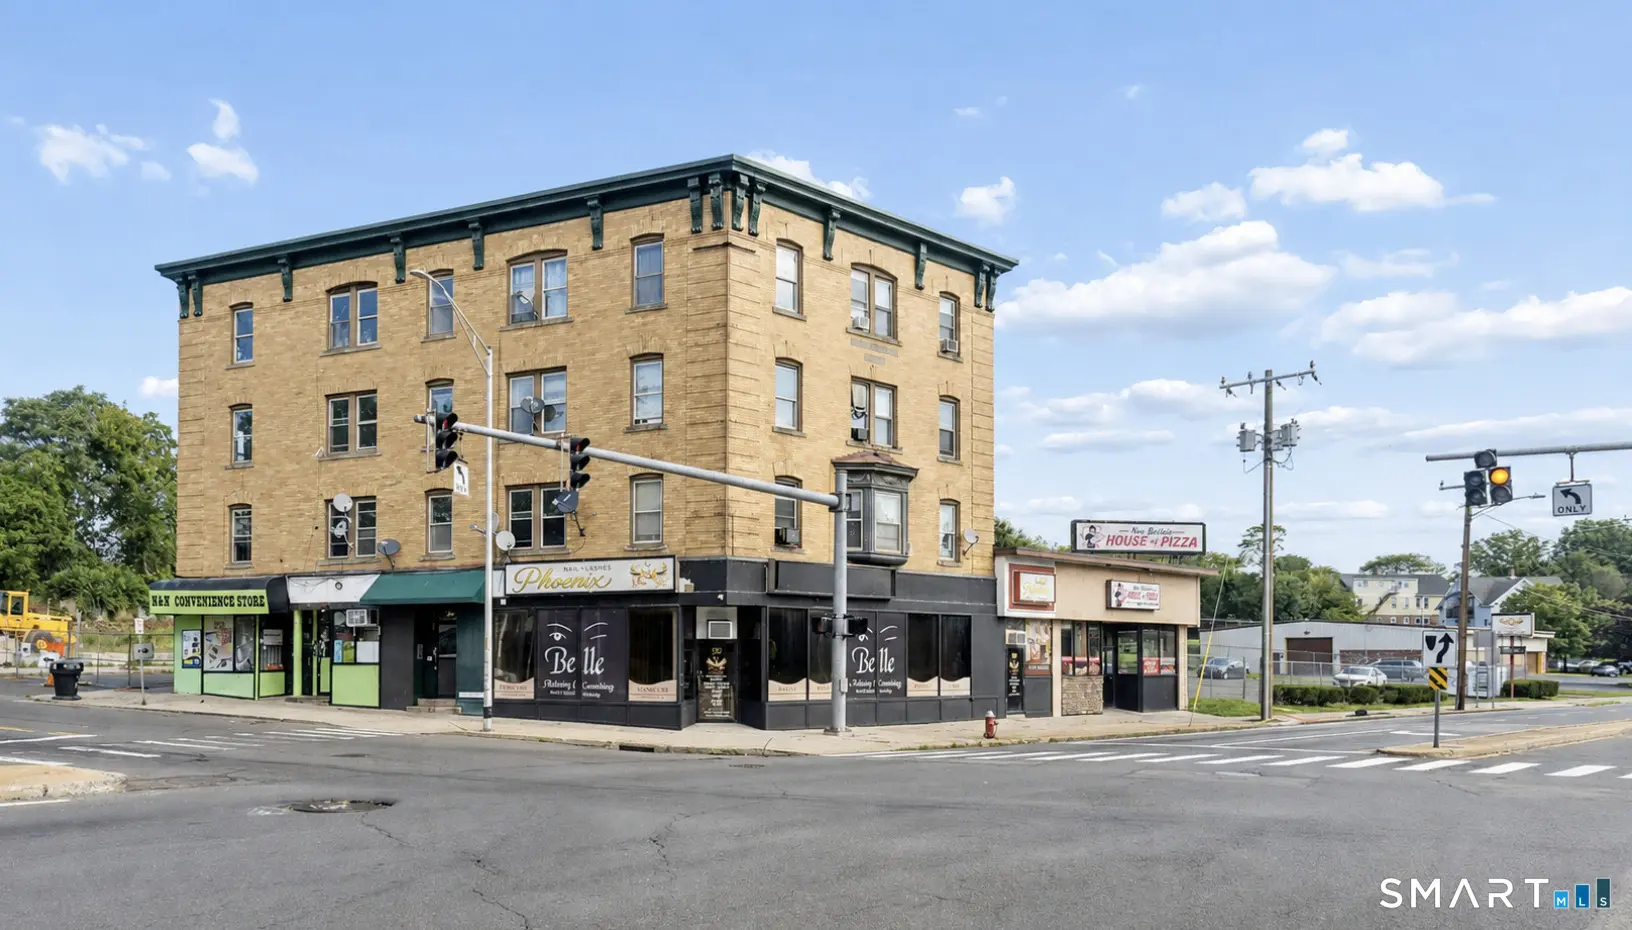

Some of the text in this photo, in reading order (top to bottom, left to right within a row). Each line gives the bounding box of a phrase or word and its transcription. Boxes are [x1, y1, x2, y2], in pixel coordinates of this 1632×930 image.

[1557, 504, 1587, 513] ONLY
[1106, 534, 1148, 547] HOUSE
[1160, 535, 1198, 549] PIZZA
[512, 566, 613, 593] Phoenix
[174, 595, 235, 607] CONVENIENCE
[236, 594, 265, 607] STORE
